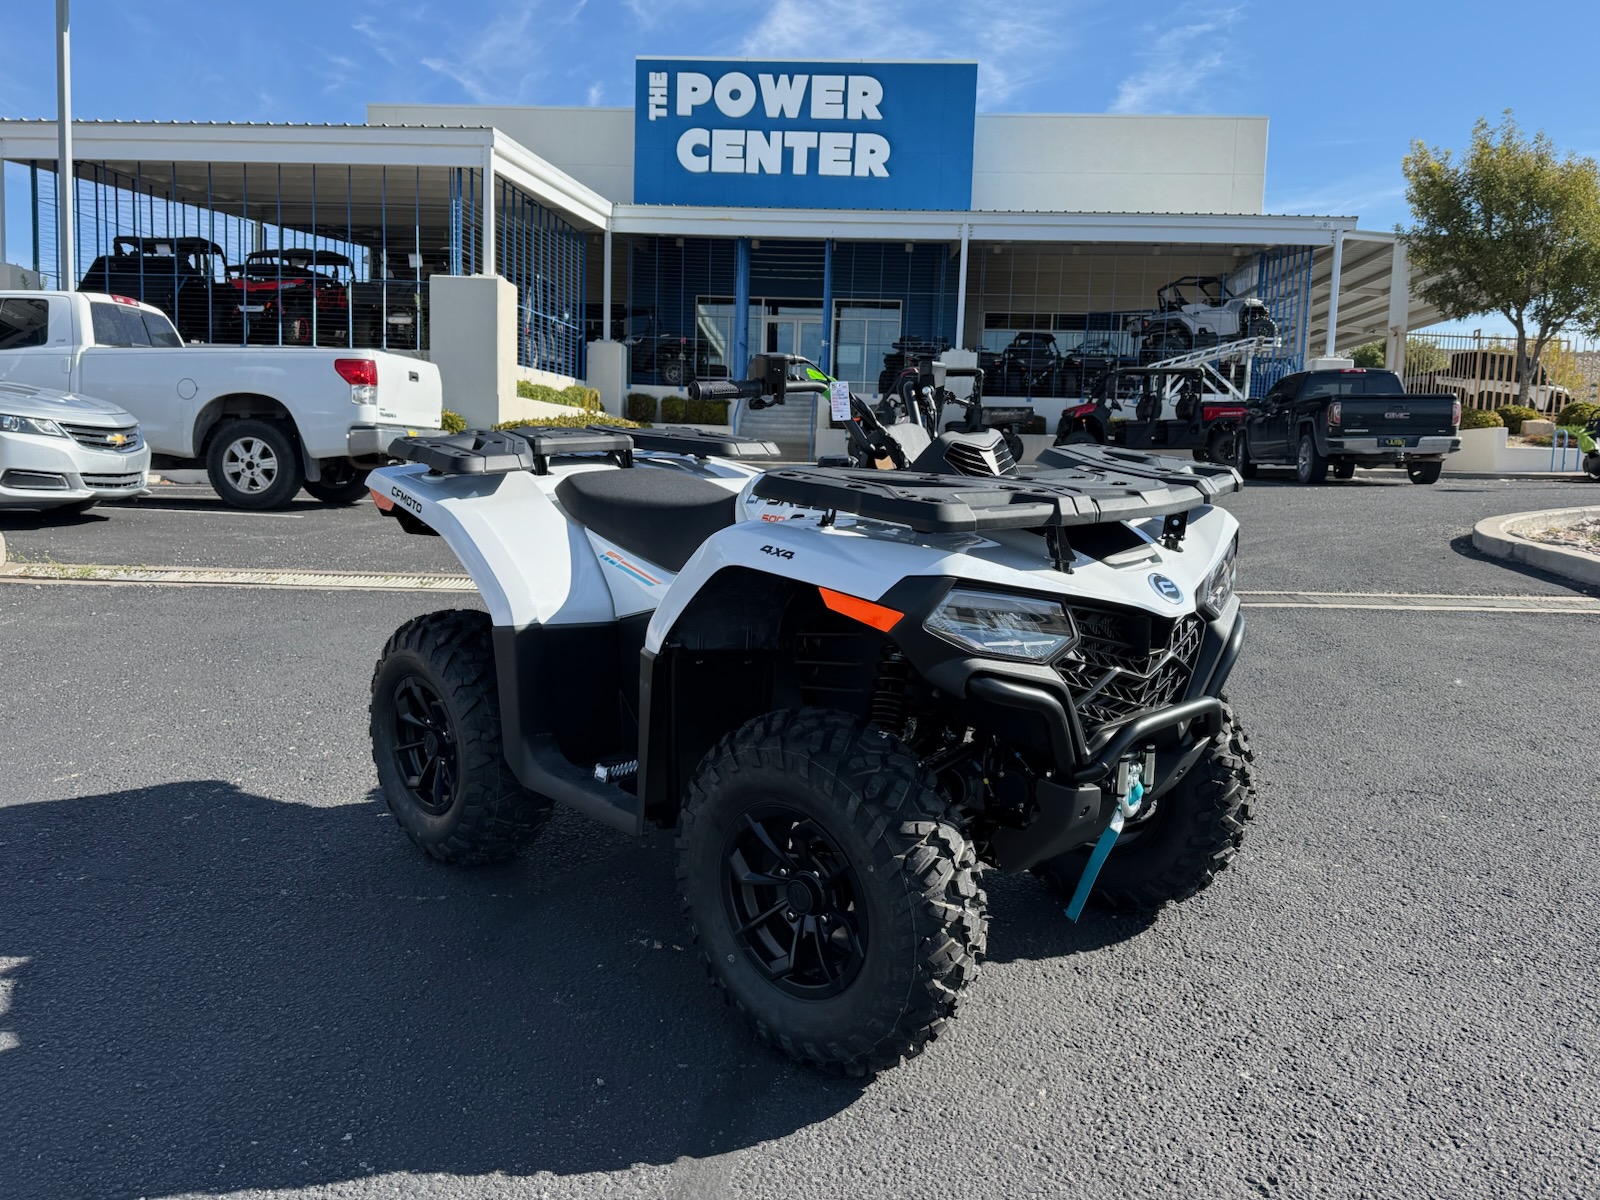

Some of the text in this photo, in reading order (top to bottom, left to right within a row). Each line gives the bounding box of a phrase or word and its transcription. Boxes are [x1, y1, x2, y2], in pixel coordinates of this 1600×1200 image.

[648, 71, 668, 121] THE
[676, 71, 884, 121] POWER
[676, 127, 891, 178] CENTER
[391, 486, 422, 513] CFMOTO
